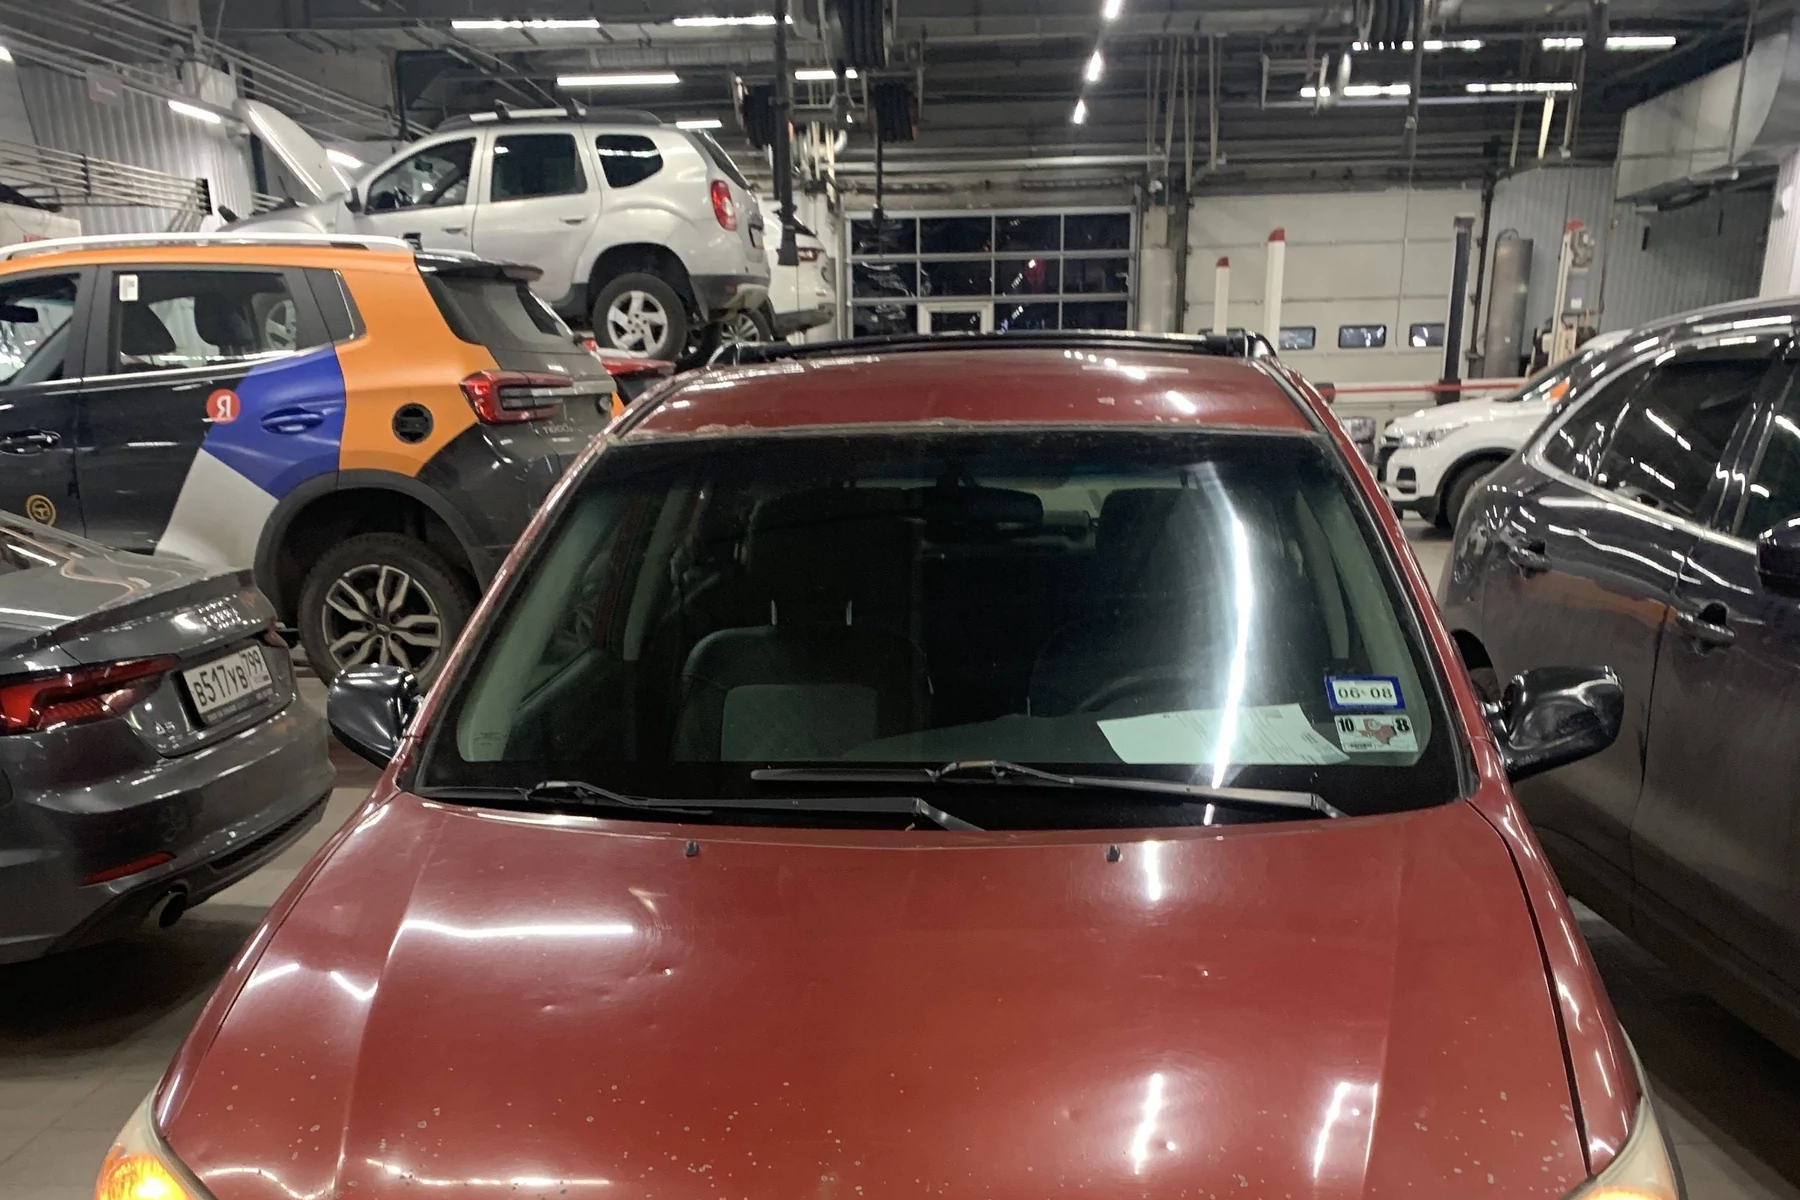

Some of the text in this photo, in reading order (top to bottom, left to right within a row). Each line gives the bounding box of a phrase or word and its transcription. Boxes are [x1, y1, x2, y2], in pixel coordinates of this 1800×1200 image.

[216, 394, 232, 419] Я
[1338, 717, 1410, 732] 10 8
